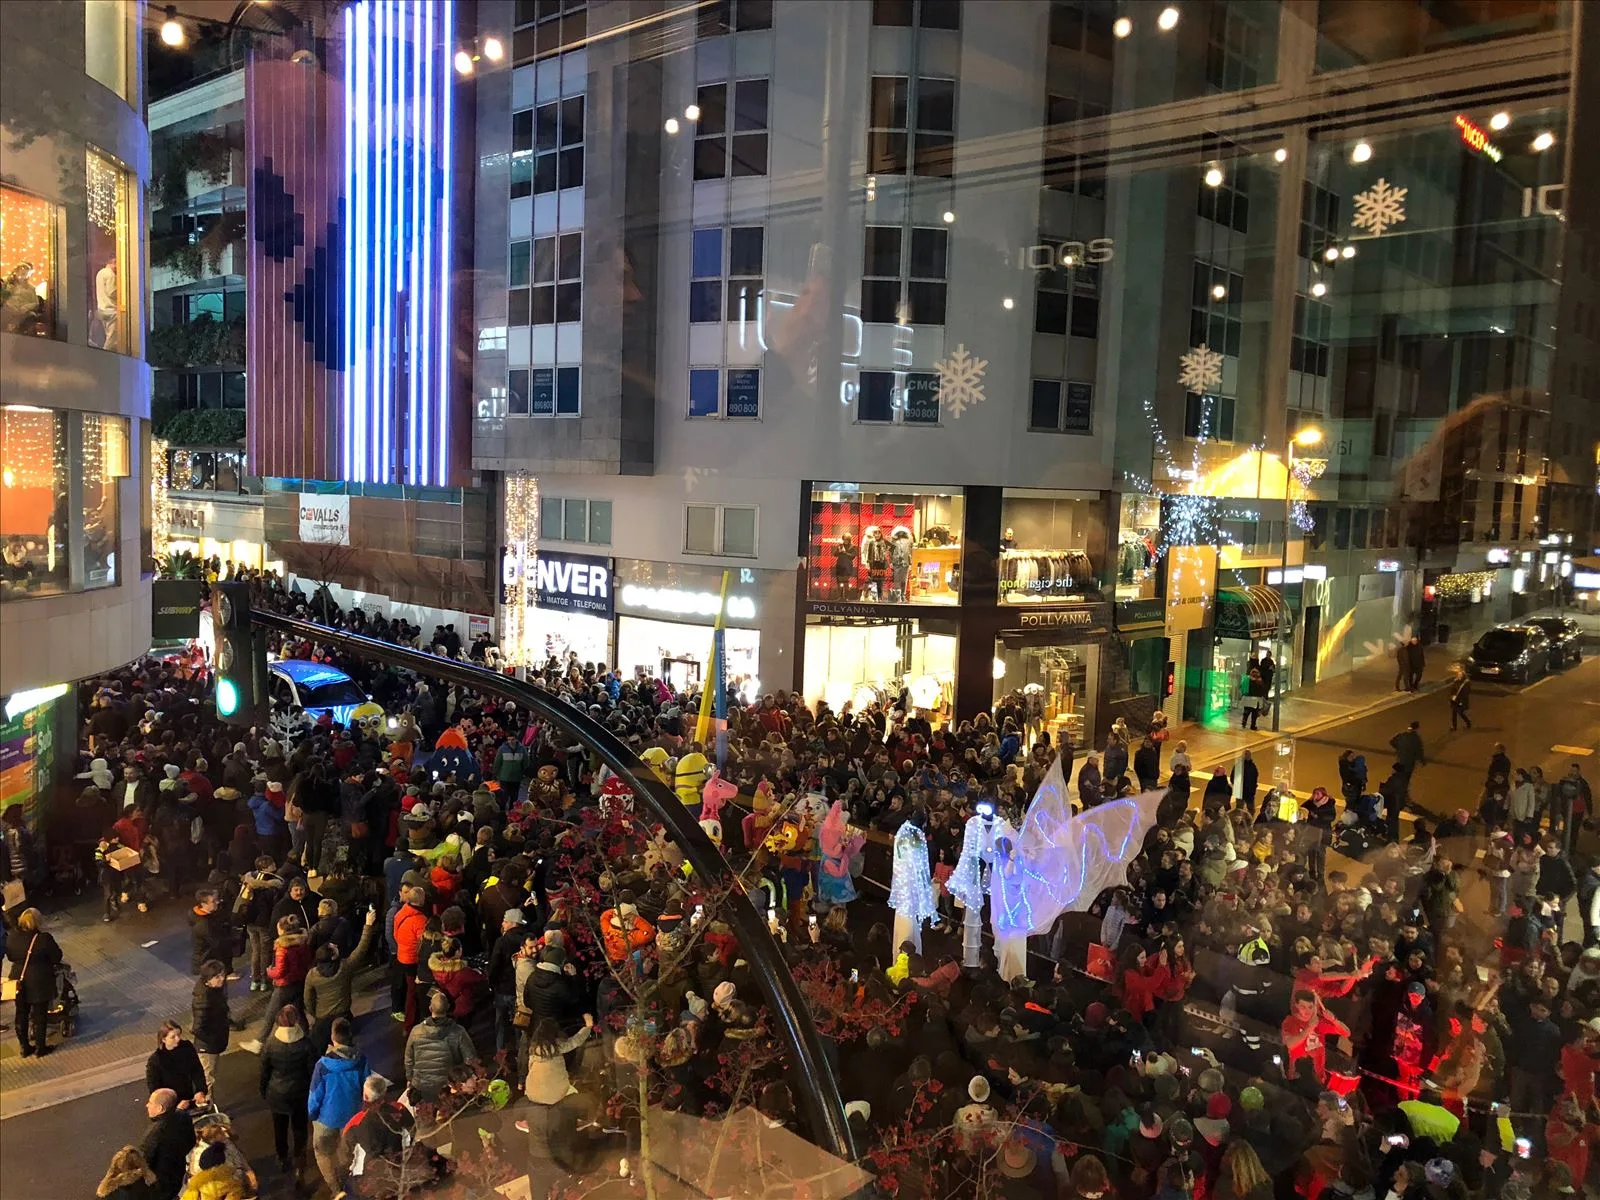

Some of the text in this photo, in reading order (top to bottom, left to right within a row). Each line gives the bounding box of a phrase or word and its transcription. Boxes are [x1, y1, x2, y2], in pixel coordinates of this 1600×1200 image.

[157, 606, 196, 615] SUBWAY
[573, 600, 607, 611] TELEFONIA
[813, 604, 876, 614] POLLYANNA
[1020, 614, 1092, 627] POLLYANNA
